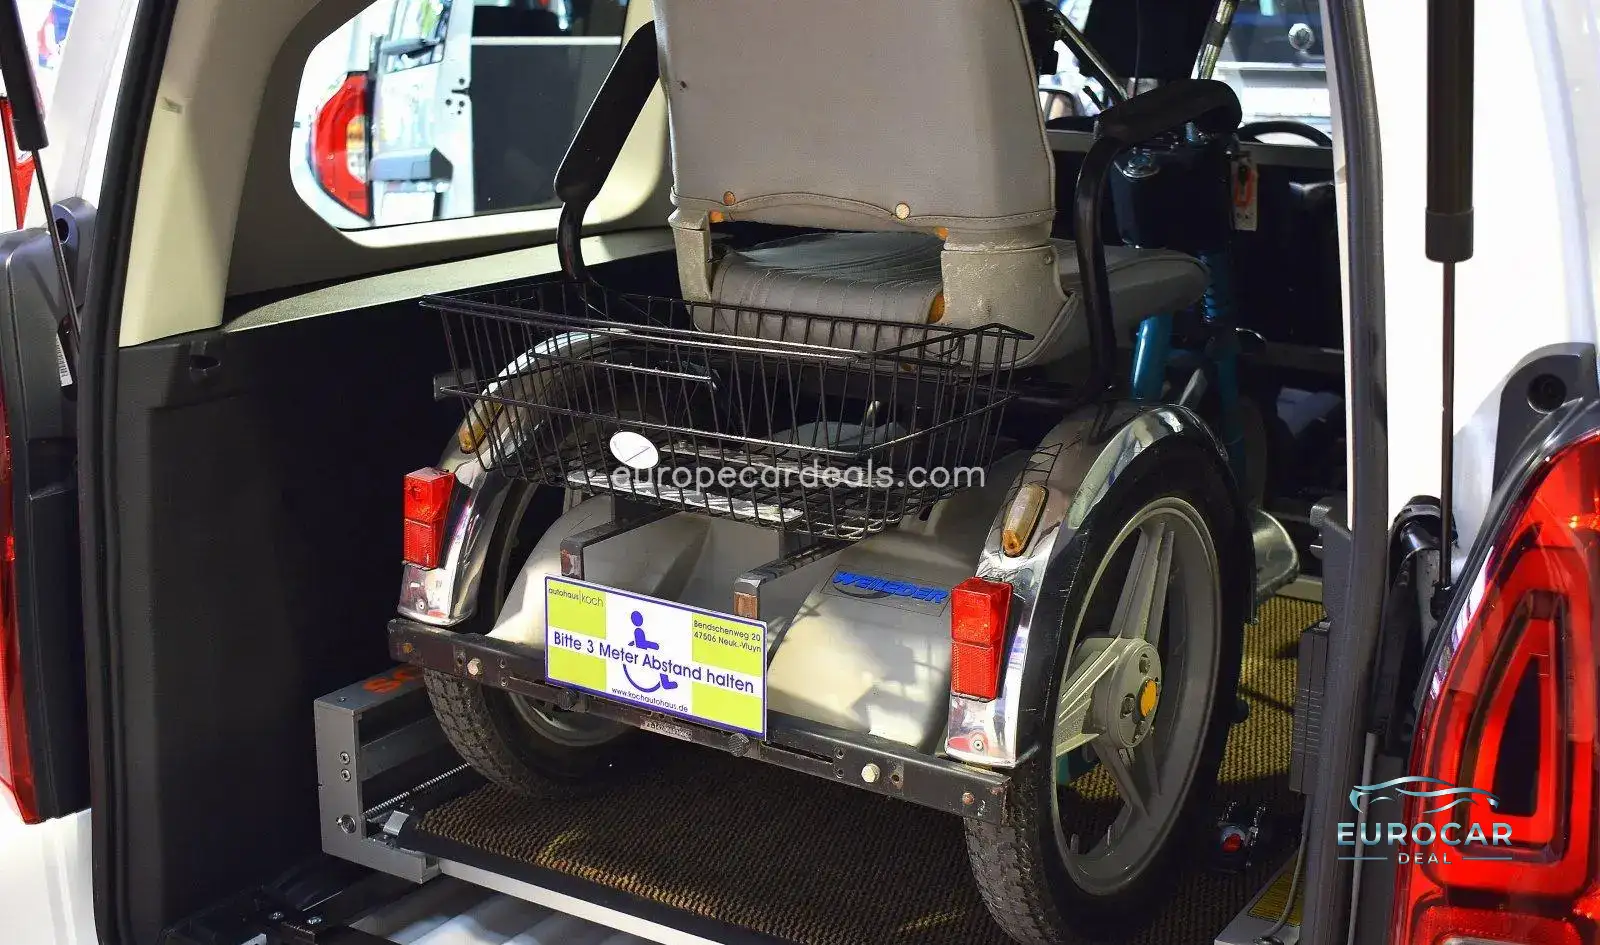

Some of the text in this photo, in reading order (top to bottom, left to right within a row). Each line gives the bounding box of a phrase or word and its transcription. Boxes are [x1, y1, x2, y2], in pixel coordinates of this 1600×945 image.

[694, 620, 761, 642] Bendschenweg 20
[694, 631, 717, 642] 47506
[554, 631, 754, 693] Bitte 3 Meter Abstand halten
[611, 687, 688, 713] www.kochautohaus.de
